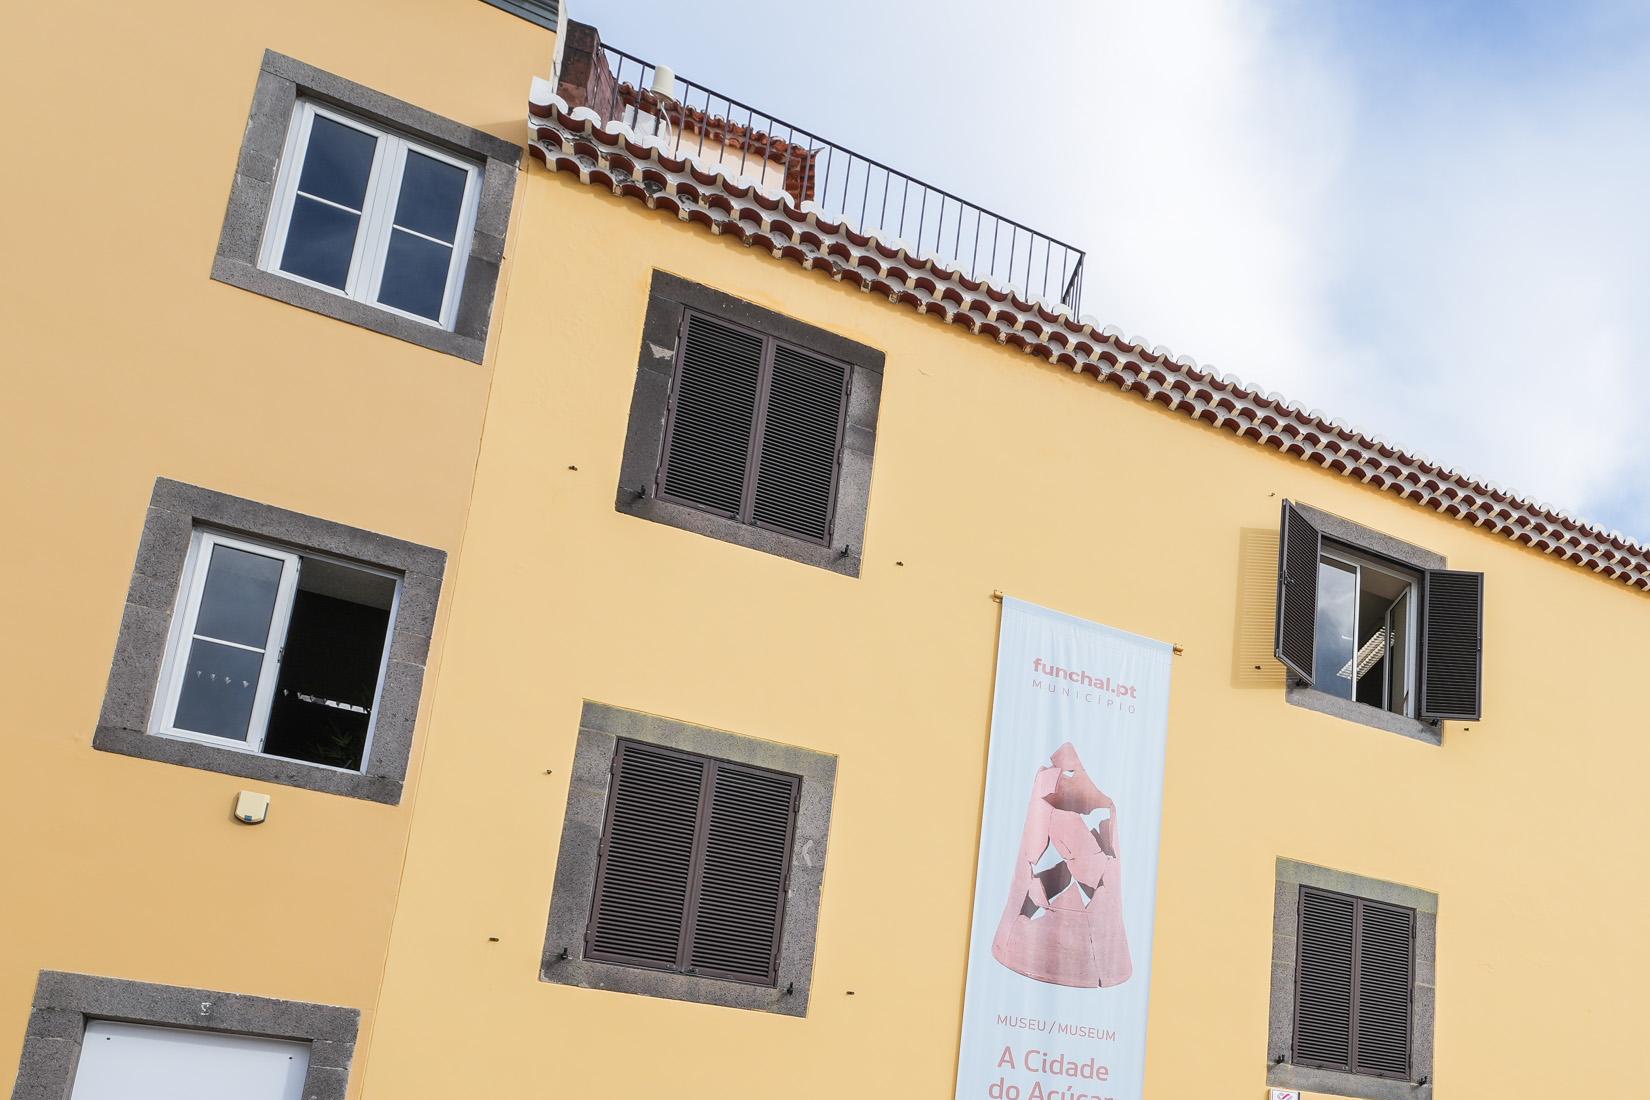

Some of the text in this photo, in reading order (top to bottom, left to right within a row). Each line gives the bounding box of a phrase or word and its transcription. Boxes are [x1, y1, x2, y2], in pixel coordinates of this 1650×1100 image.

[1032, 657, 1137, 700] funchal.pt
[997, 1046, 1109, 1082] A Cidade
[988, 1077, 1021, 1100] do
